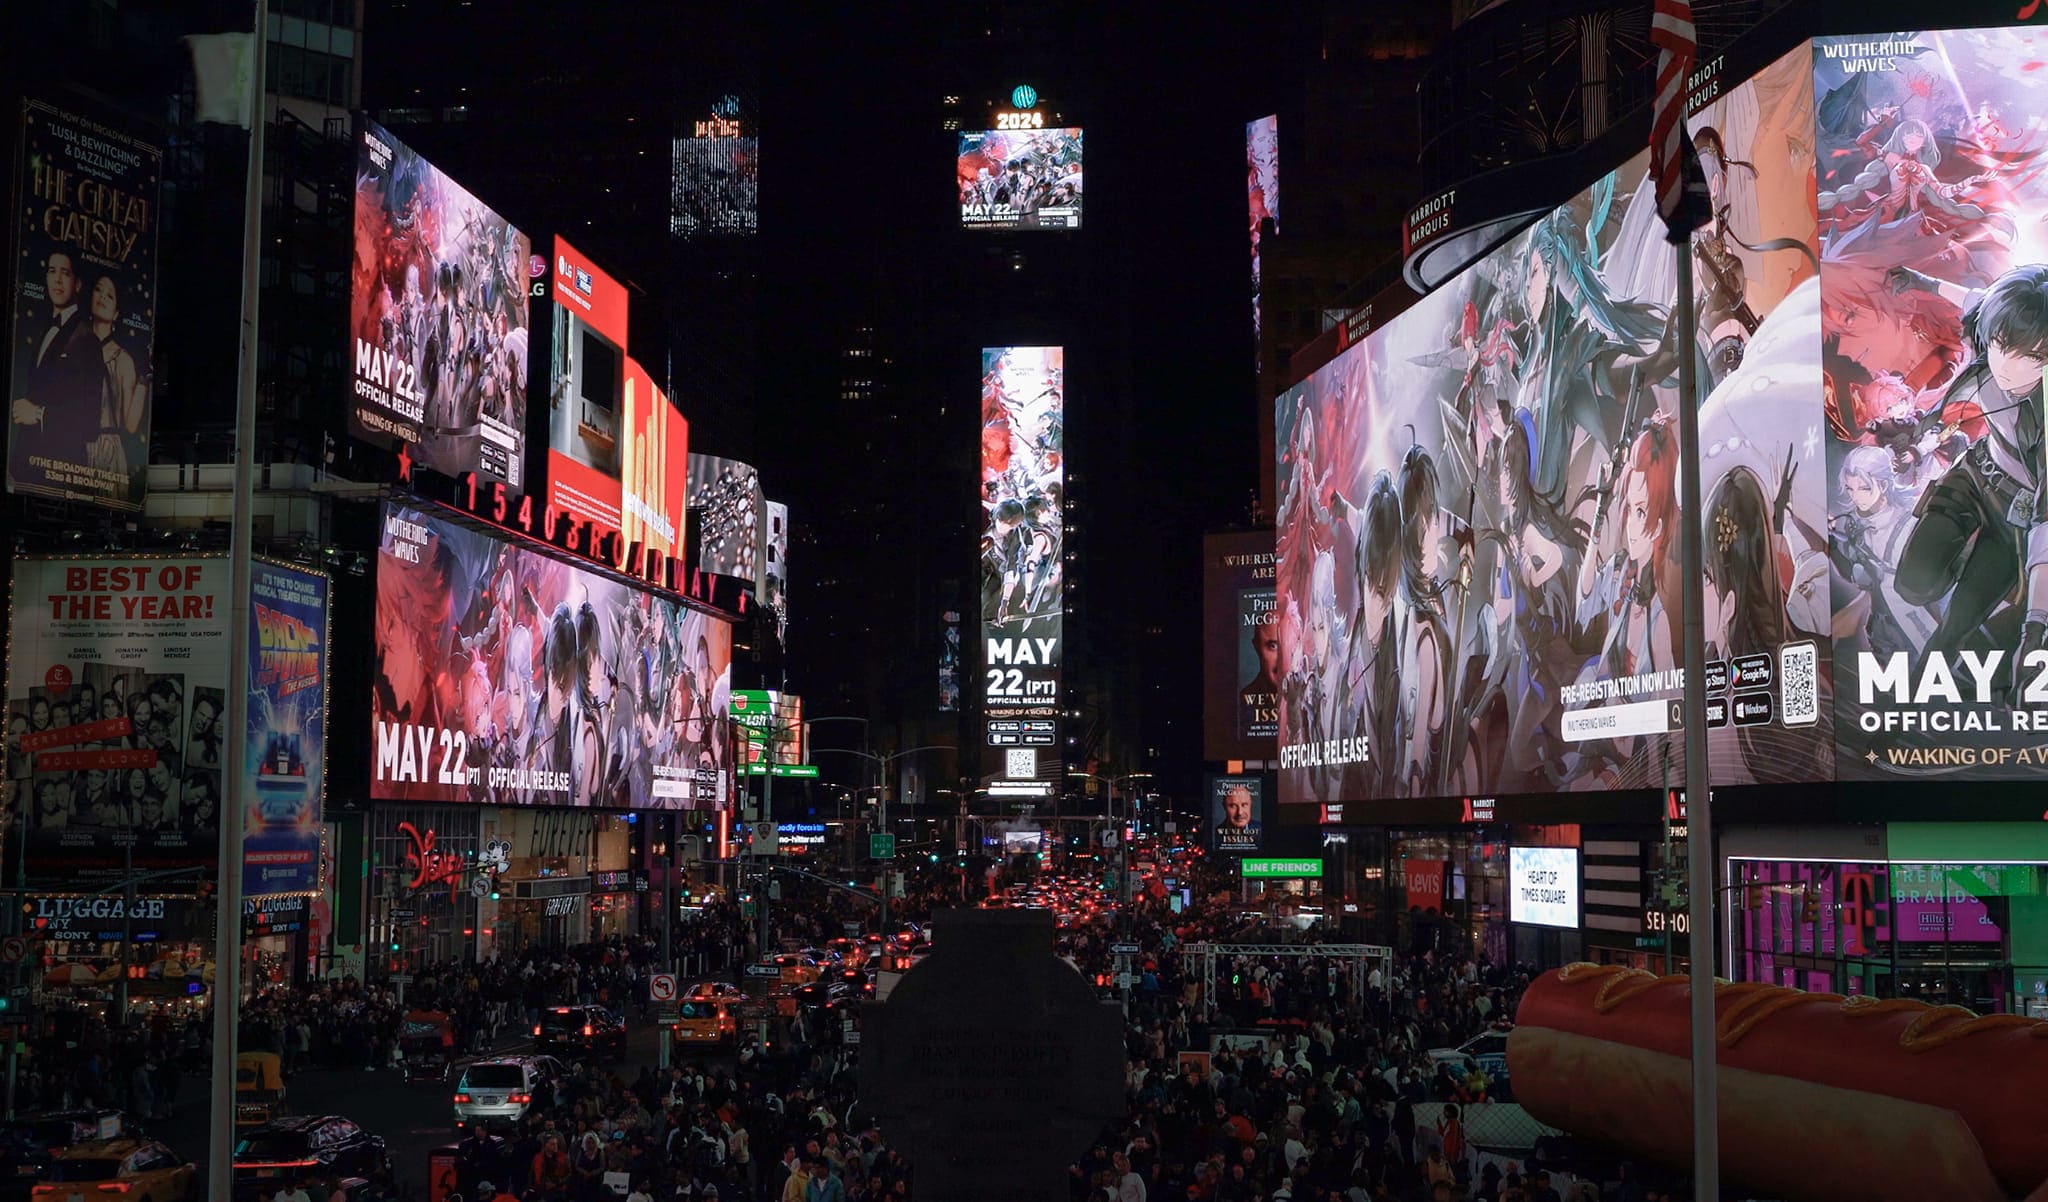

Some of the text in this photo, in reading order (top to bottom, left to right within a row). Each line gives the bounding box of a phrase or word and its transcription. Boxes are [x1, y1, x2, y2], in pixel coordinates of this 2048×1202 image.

[1823, 40, 1917, 59] WUTHERING
[1685, 55, 1725, 96] RRIOTT
[1840, 59, 1897, 73] WAVES
[1685, 81, 1719, 113] RQUIS
[60, 110, 133, 145] NOW ON BROADWAY
[996, 112, 1044, 130] 2024
[64, 144, 73, 157] &
[79, 135, 141, 168] BEWITCHING
[31, 163, 149, 234] THE GREAT
[962, 203, 1011, 216] MAY 22
[1410, 190, 1457, 229] MARRIOTT
[43, 204, 138, 263] GATSBY
[1410, 213, 1449, 247] MARQUIS
[1348, 303, 1373, 329] MARRIOTT
[1348, 320, 1370, 344] MARQUIS
[355, 337, 415, 400] MAY 22
[355, 379, 424, 425] OFFICIAL RELEASE
[361, 409, 418, 444] WAKING OF A WORLD
[29, 455, 130, 484] @THE BROADWAY THEATRE
[65, 473, 73, 483] &
[73, 475, 115, 491] BROADWAY
[386, 514, 428, 546] WUTHERING
[465, 471, 556, 542] 1540
[565, 512, 719, 605] BROADWAY
[394, 539, 420, 564] WAVES
[1223, 553, 1277, 567] WHEREV
[66, 565, 202, 592] BEST OF
[1251, 567, 1276, 579] ARE
[253, 583, 278, 599] MUSICAL
[301, 595, 322, 608] HISTORY
[294, 581, 315, 596] CHANGE
[48, 595, 214, 620] THE YEAR!
[255, 602, 319, 651] BACK
[987, 637, 1057, 666] MAY
[986, 668, 1057, 696] 22 (PT)
[1560, 668, 1685, 704] PRE-REGISTRATION NOW LIVE
[1711, 674, 1726, 687] Store
[1741, 667, 1770, 682] Google Play
[1857, 649, 2048, 705] MAY 2
[986, 697, 1057, 705] OFFICIAL RELEASE
[1031, 708, 1053, 716] WORLD
[1744, 702, 1768, 714] Windows
[1567, 715, 1617, 732] WUTHERING WAVES
[1859, 710, 2048, 733] OFFICIAL RE
[21, 720, 126, 748] MERRILY WE
[43, 752, 151, 767] ROLL ALONG
[376, 721, 435, 783] MAY
[437, 728, 468, 786] 22
[1280, 736, 1369, 770] OFFICIAL RELEASE
[1887, 748, 2034, 765] WAKING OF A
[488, 768, 571, 792] OFFICIAL RELEASE
[1472, 798, 1496, 808] MARRIOTT
[1472, 810, 1494, 820] MARQUIS
[529, 809, 593, 858] FOREVER
[1216, 828, 1259, 836] WE'VE GOT
[1223, 836, 1255, 844] ISSUES
[396, 819, 464, 906] Disney
[1243, 861, 1318, 873] LINE FRIENDS
[1528, 870, 1558, 885] HEART OF
[261, 896, 303, 913] LUGGAGE
[545, 896, 572, 917] FOREVER
[1521, 888, 1566, 904] TIMES SQUARE
[37, 899, 165, 919] LUGGAGE
[30, 918, 71, 930] I NY
[54, 931, 90, 940] SONY
[272, 924, 288, 932] SONY
